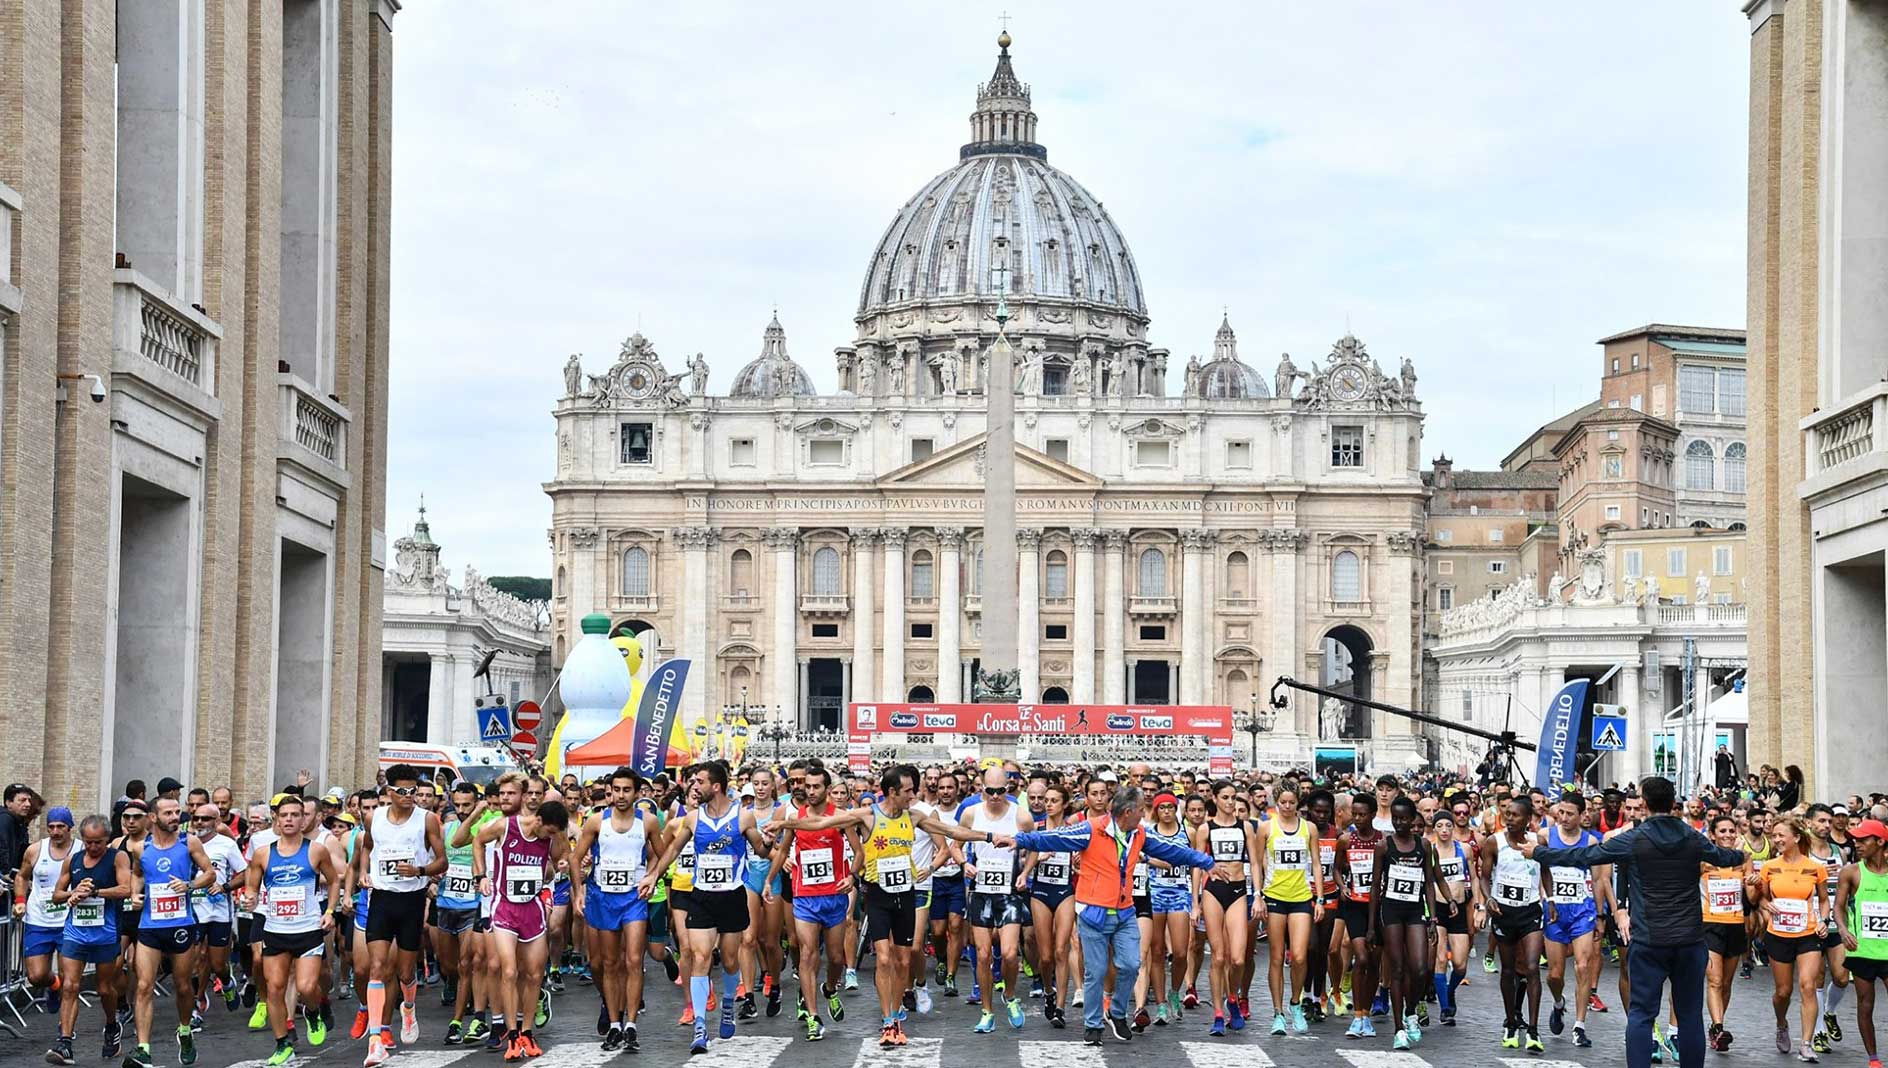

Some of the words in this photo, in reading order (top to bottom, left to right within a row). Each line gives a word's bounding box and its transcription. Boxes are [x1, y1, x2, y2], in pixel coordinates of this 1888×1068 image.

[686, 498, 702, 509] IN
[708, 498, 774, 509] HONOREM
[777, 498, 842, 509] PRINCIPIS
[1026, 498, 1094, 512] ROMANVS
[1275, 501, 1295, 512] VII
[925, 715, 955, 726] teva
[983, 712, 1020, 732] Corsa
[1033, 713, 1065, 732] Santi
[1142, 717, 1172, 728] teva
[1221, 842, 1235, 852] F6
[1284, 852, 1297, 862] F8
[810, 864, 825, 875] 13
[1047, 866, 1060, 876] F5
[609, 872, 626, 884] 25
[707, 870, 724, 882] 29
[887, 872, 904, 884] 15
[986, 873, 1003, 884] 23
[452, 879, 468, 890] 20
[520, 881, 530, 894] 4
[1397, 881, 1411, 892] F2
[1558, 884, 1575, 895] 26
[1509, 887, 1517, 899] 3
[1716, 894, 1735, 905] F31
[158, 902, 178, 911] 151
[278, 905, 298, 914] 292
[1780, 914, 1800, 924] F56
[1871, 917, 1888, 931] 22
